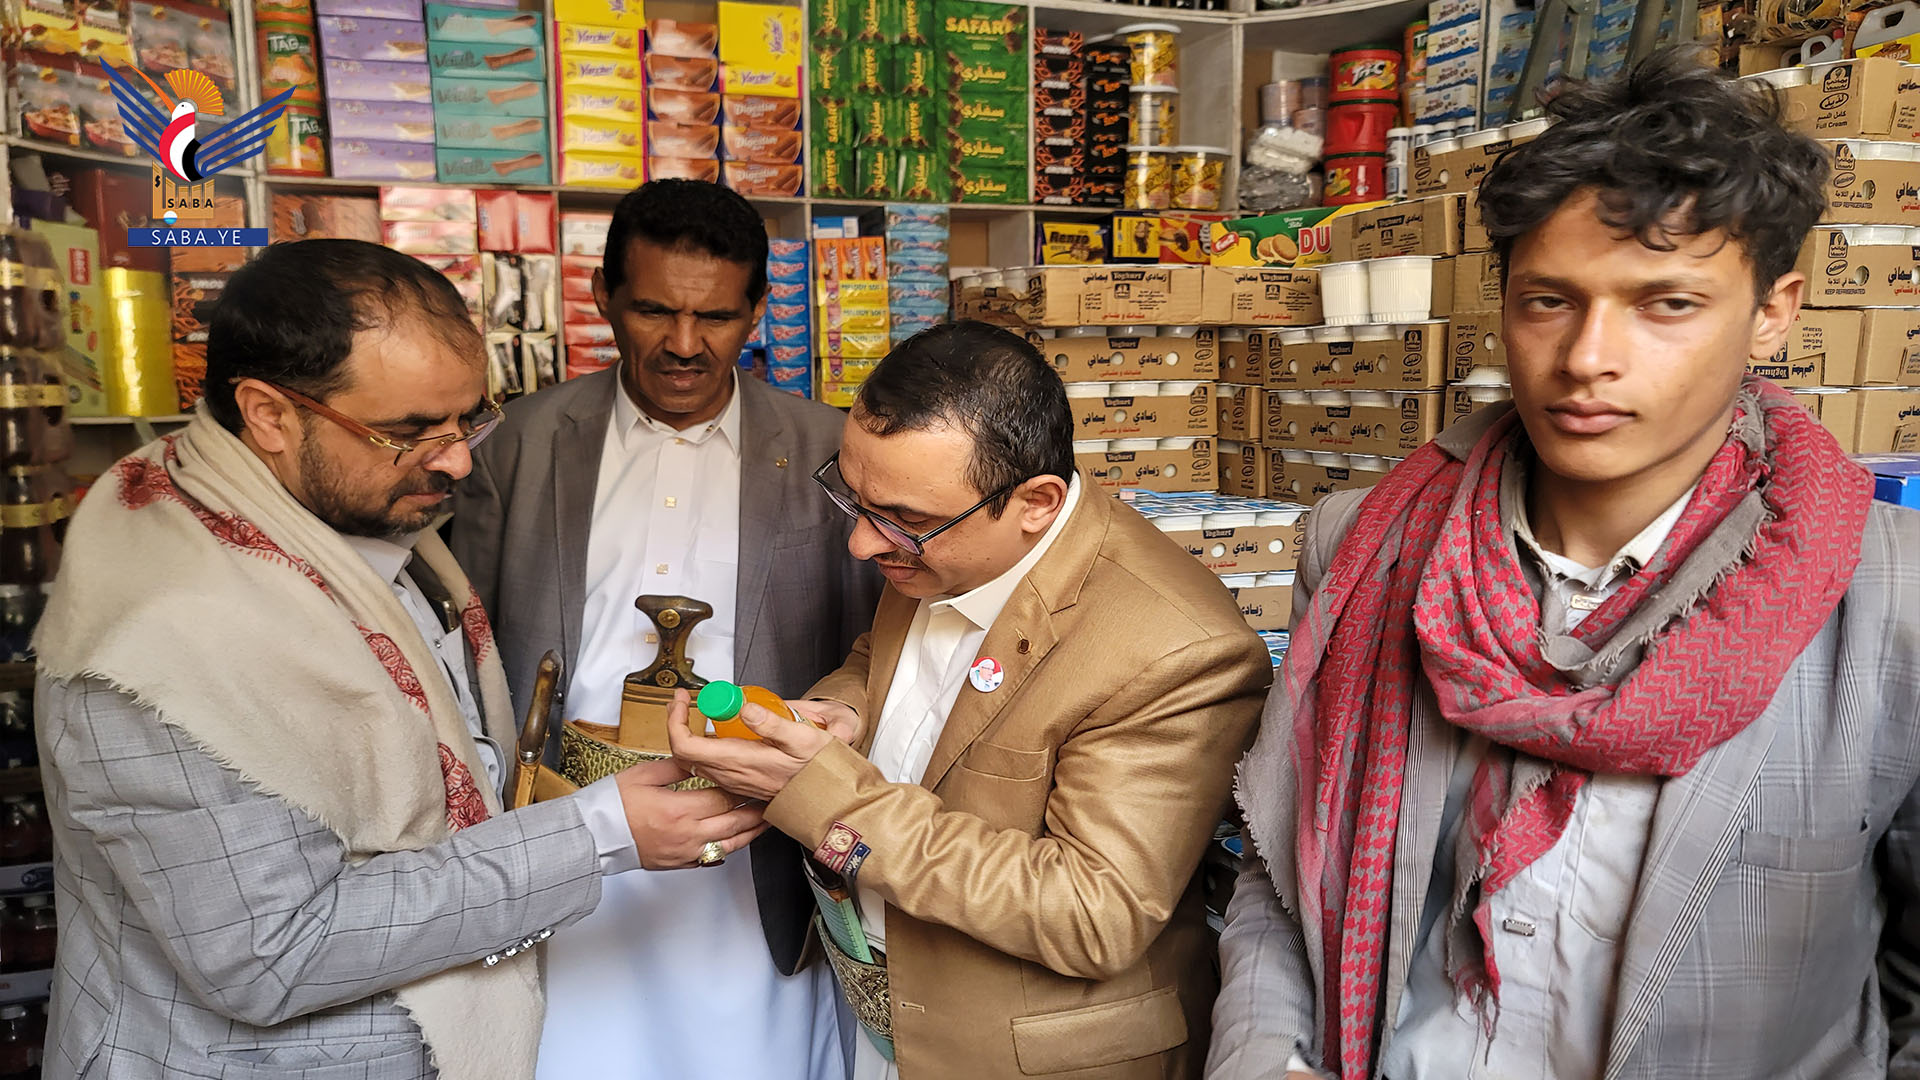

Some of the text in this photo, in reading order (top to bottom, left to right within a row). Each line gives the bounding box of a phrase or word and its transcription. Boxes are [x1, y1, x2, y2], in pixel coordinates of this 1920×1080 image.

[268, 35, 300, 52] TAG
[1816, 120, 1848, 130] Full Cream
[1756, 368, 1787, 378] Yoghurt
[1205, 529, 1232, 537] Yoghurt
[1233, 541, 1258, 557] زبادي
